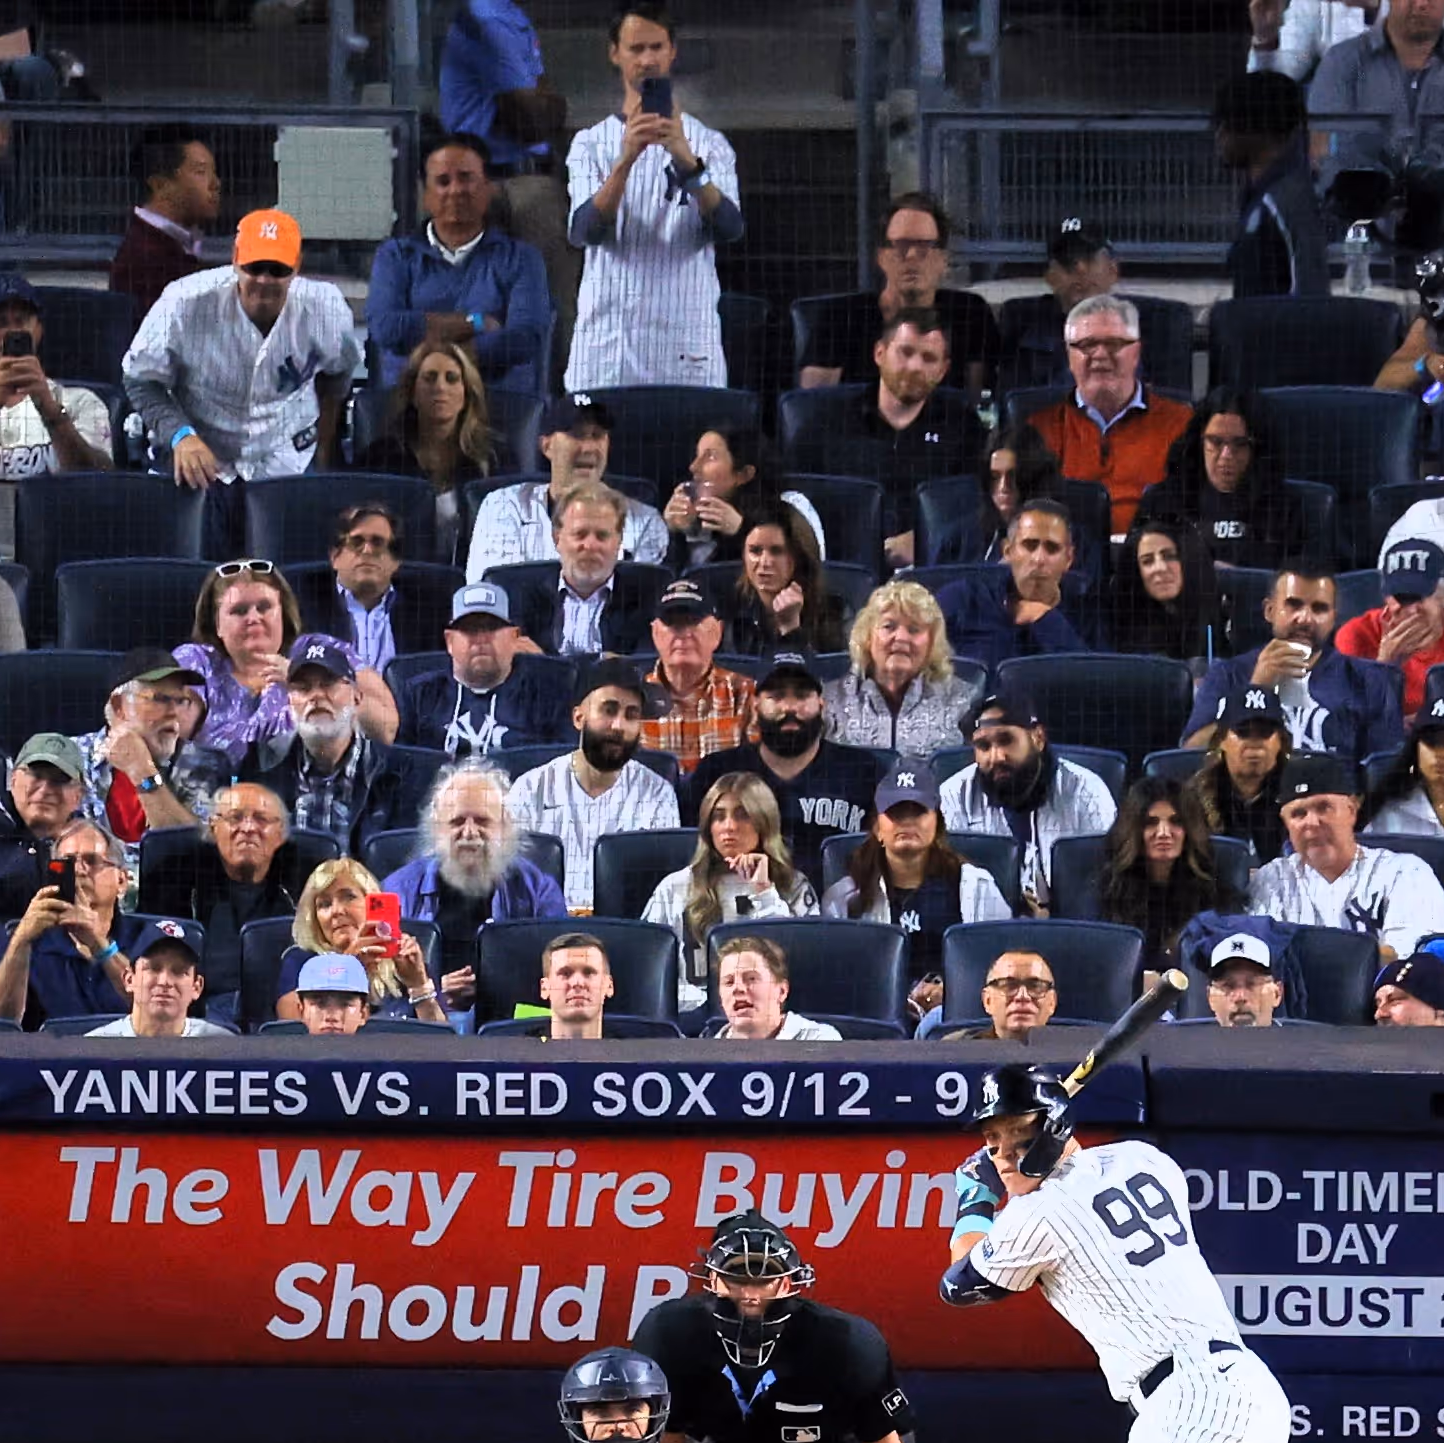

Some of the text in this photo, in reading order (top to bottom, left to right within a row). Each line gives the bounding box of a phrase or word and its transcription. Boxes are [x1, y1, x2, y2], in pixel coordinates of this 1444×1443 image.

[799, 797, 864, 834] YORK
[40, 1069, 308, 1115] YANKEES
[332, 1071, 429, 1116] VS.
[457, 1072, 568, 1116] RED
[593, 1071, 717, 1117] SOX
[741, 1071, 871, 1118] 9/12
[935, 1071, 977, 1117] 9
[59, 1146, 958, 1247] The Way Tire Buyin
[1092, 1171, 1188, 1268] 99
[1297, 1222, 1399, 1265] DAY
[266, 1261, 606, 1342] Should
[1234, 1285, 1425, 1328] UGUST
[886, 1395, 903, 1412] LP
[1291, 1405, 1324, 1436] S.
[1342, 1405, 1421, 1437] RED
